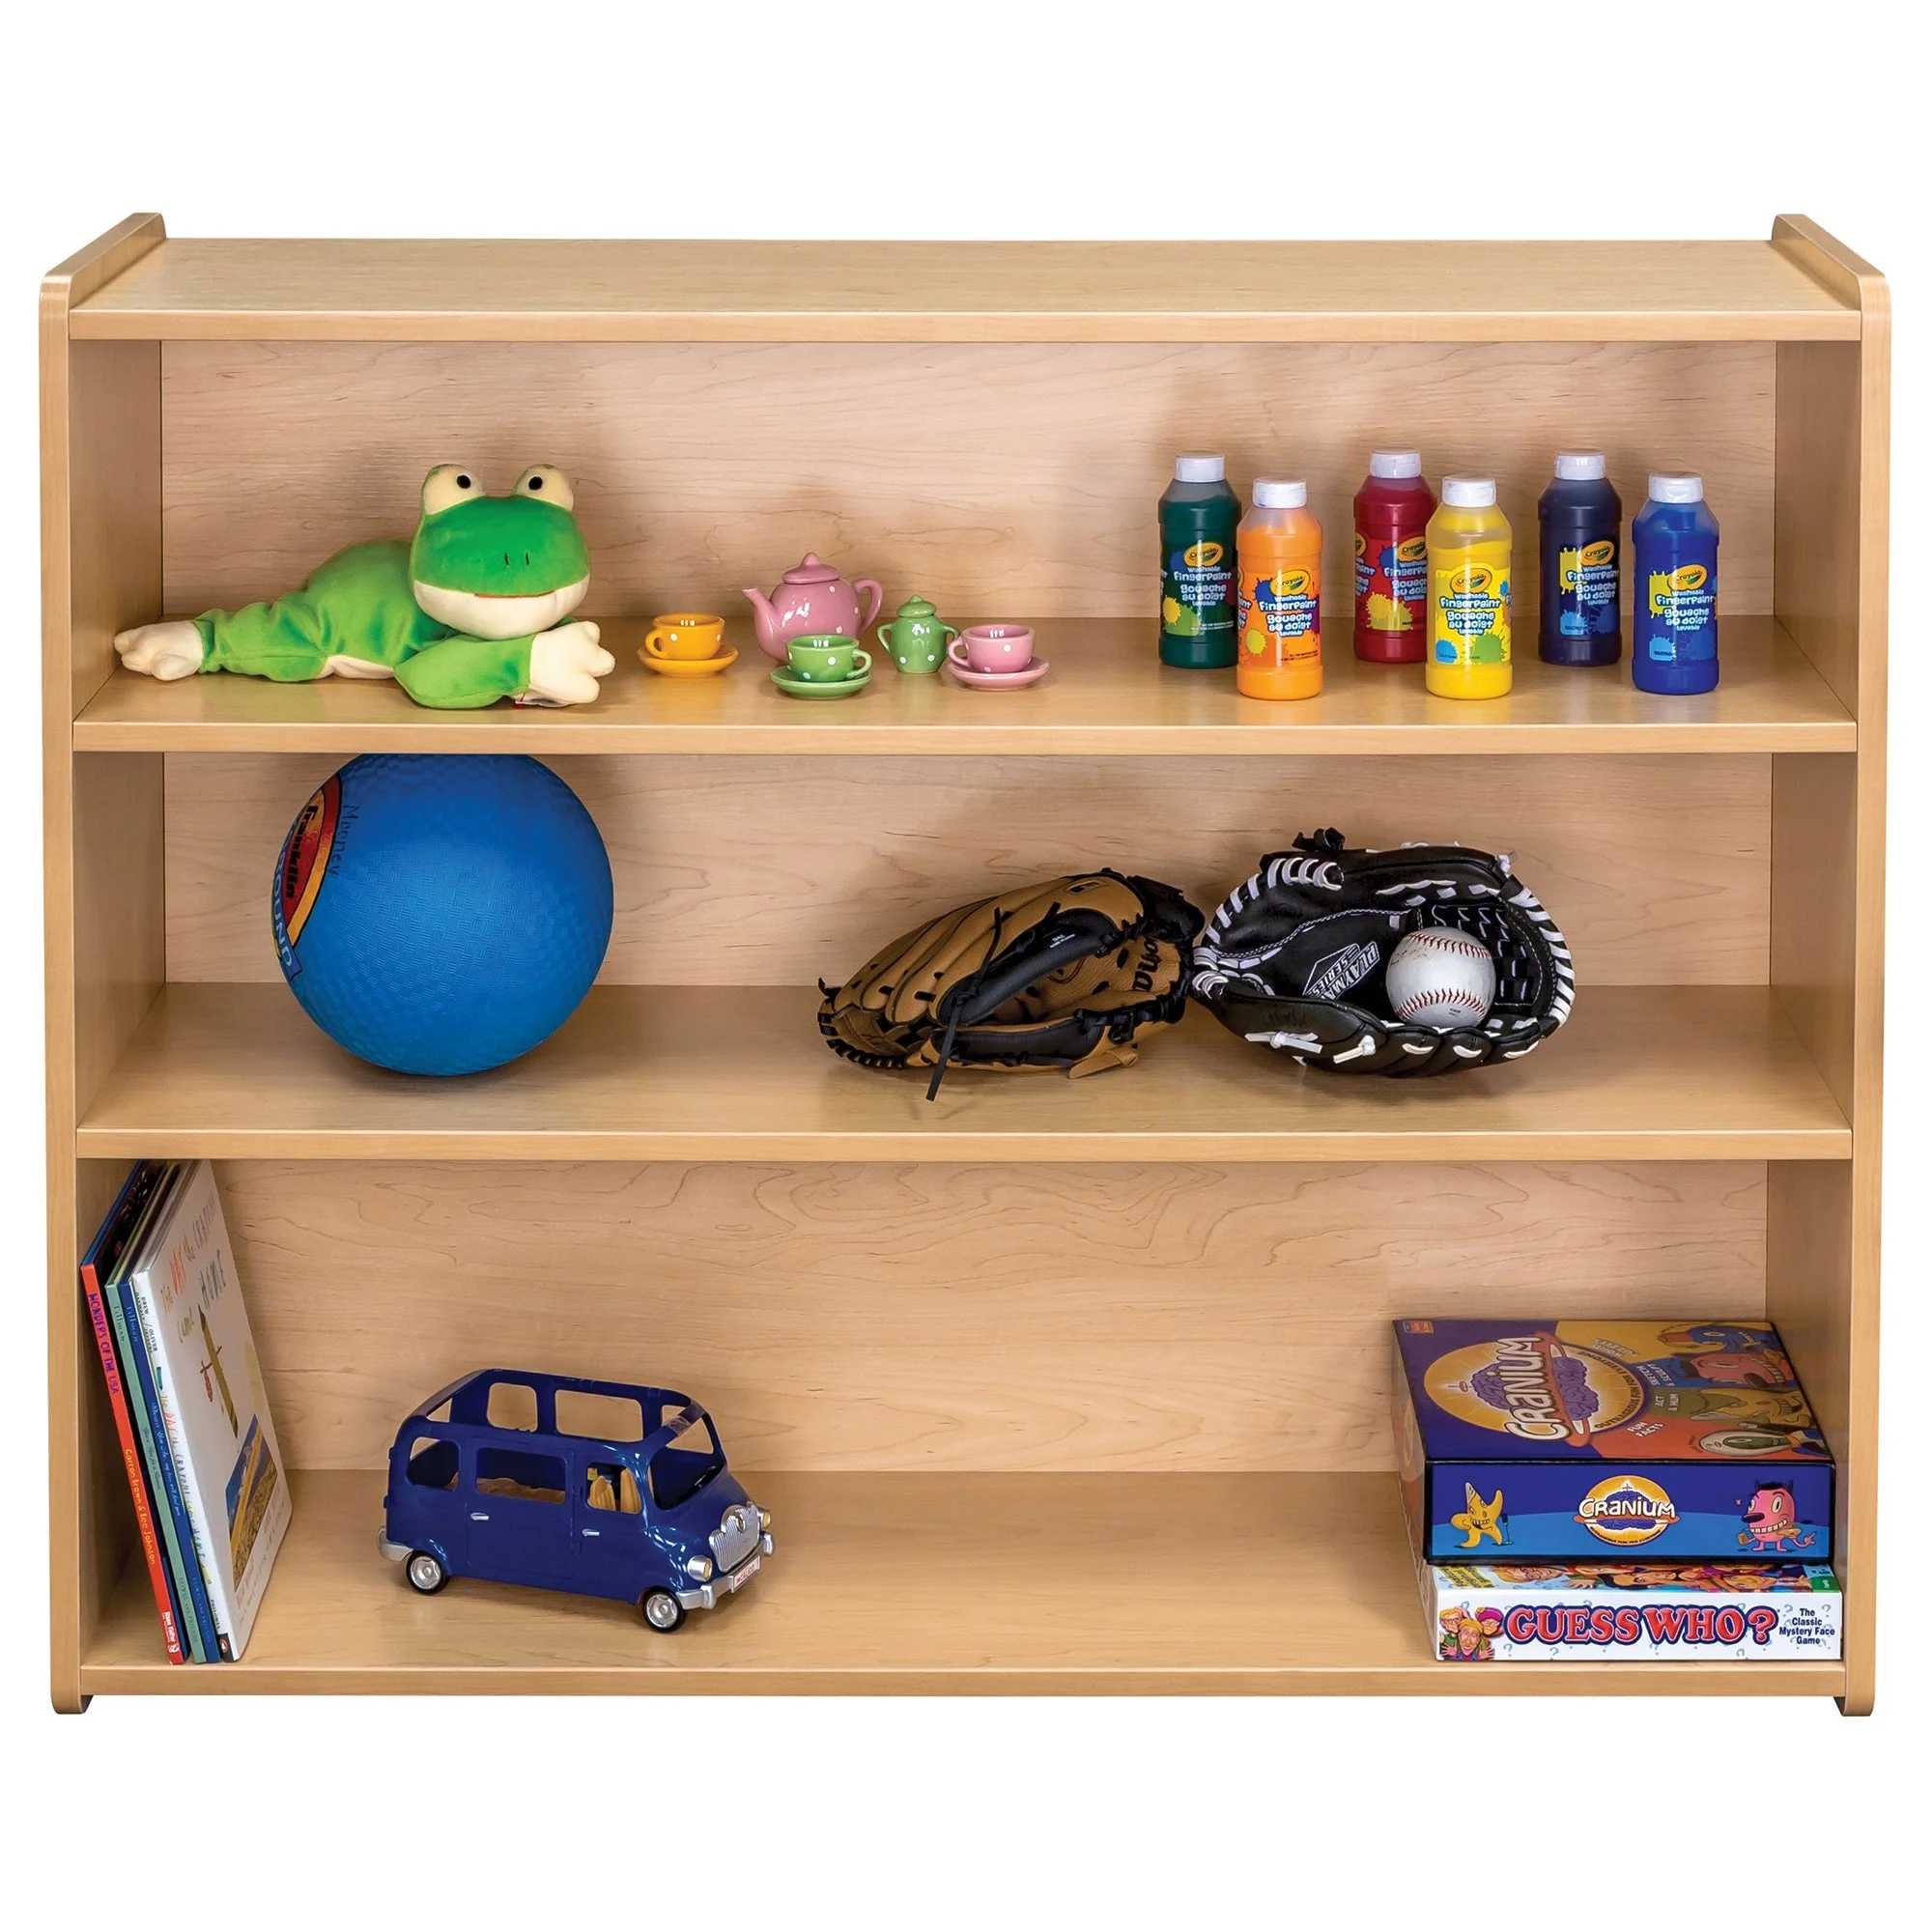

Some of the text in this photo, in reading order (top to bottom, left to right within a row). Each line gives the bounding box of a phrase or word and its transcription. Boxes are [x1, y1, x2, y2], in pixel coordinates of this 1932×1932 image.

[1402, 541, 1426, 553] Crayo
[1585, 546, 1609, 556] Crayola
[286, 805, 320, 899] Franklin
[1312, 957, 1349, 997] SERIES
[1321, 945, 1378, 1000] PLAYMA
[114, 1305, 125, 1342] Tillman
[141, 1296, 150, 1315] DREW
[149, 1328, 158, 1351] OLIVER
[89, 1293, 120, 1394] WONDERS OF THE USA
[1627, 1421, 1648, 1433] FUN
[1635, 1423, 1663, 1437] FACTS
[144, 1531, 156, 1565] Johnson
[1505, 1605, 1641, 1643] GUESS
[1779, 1627, 1812, 1636] Mystery
[1792, 1617, 1823, 1626] Classic
